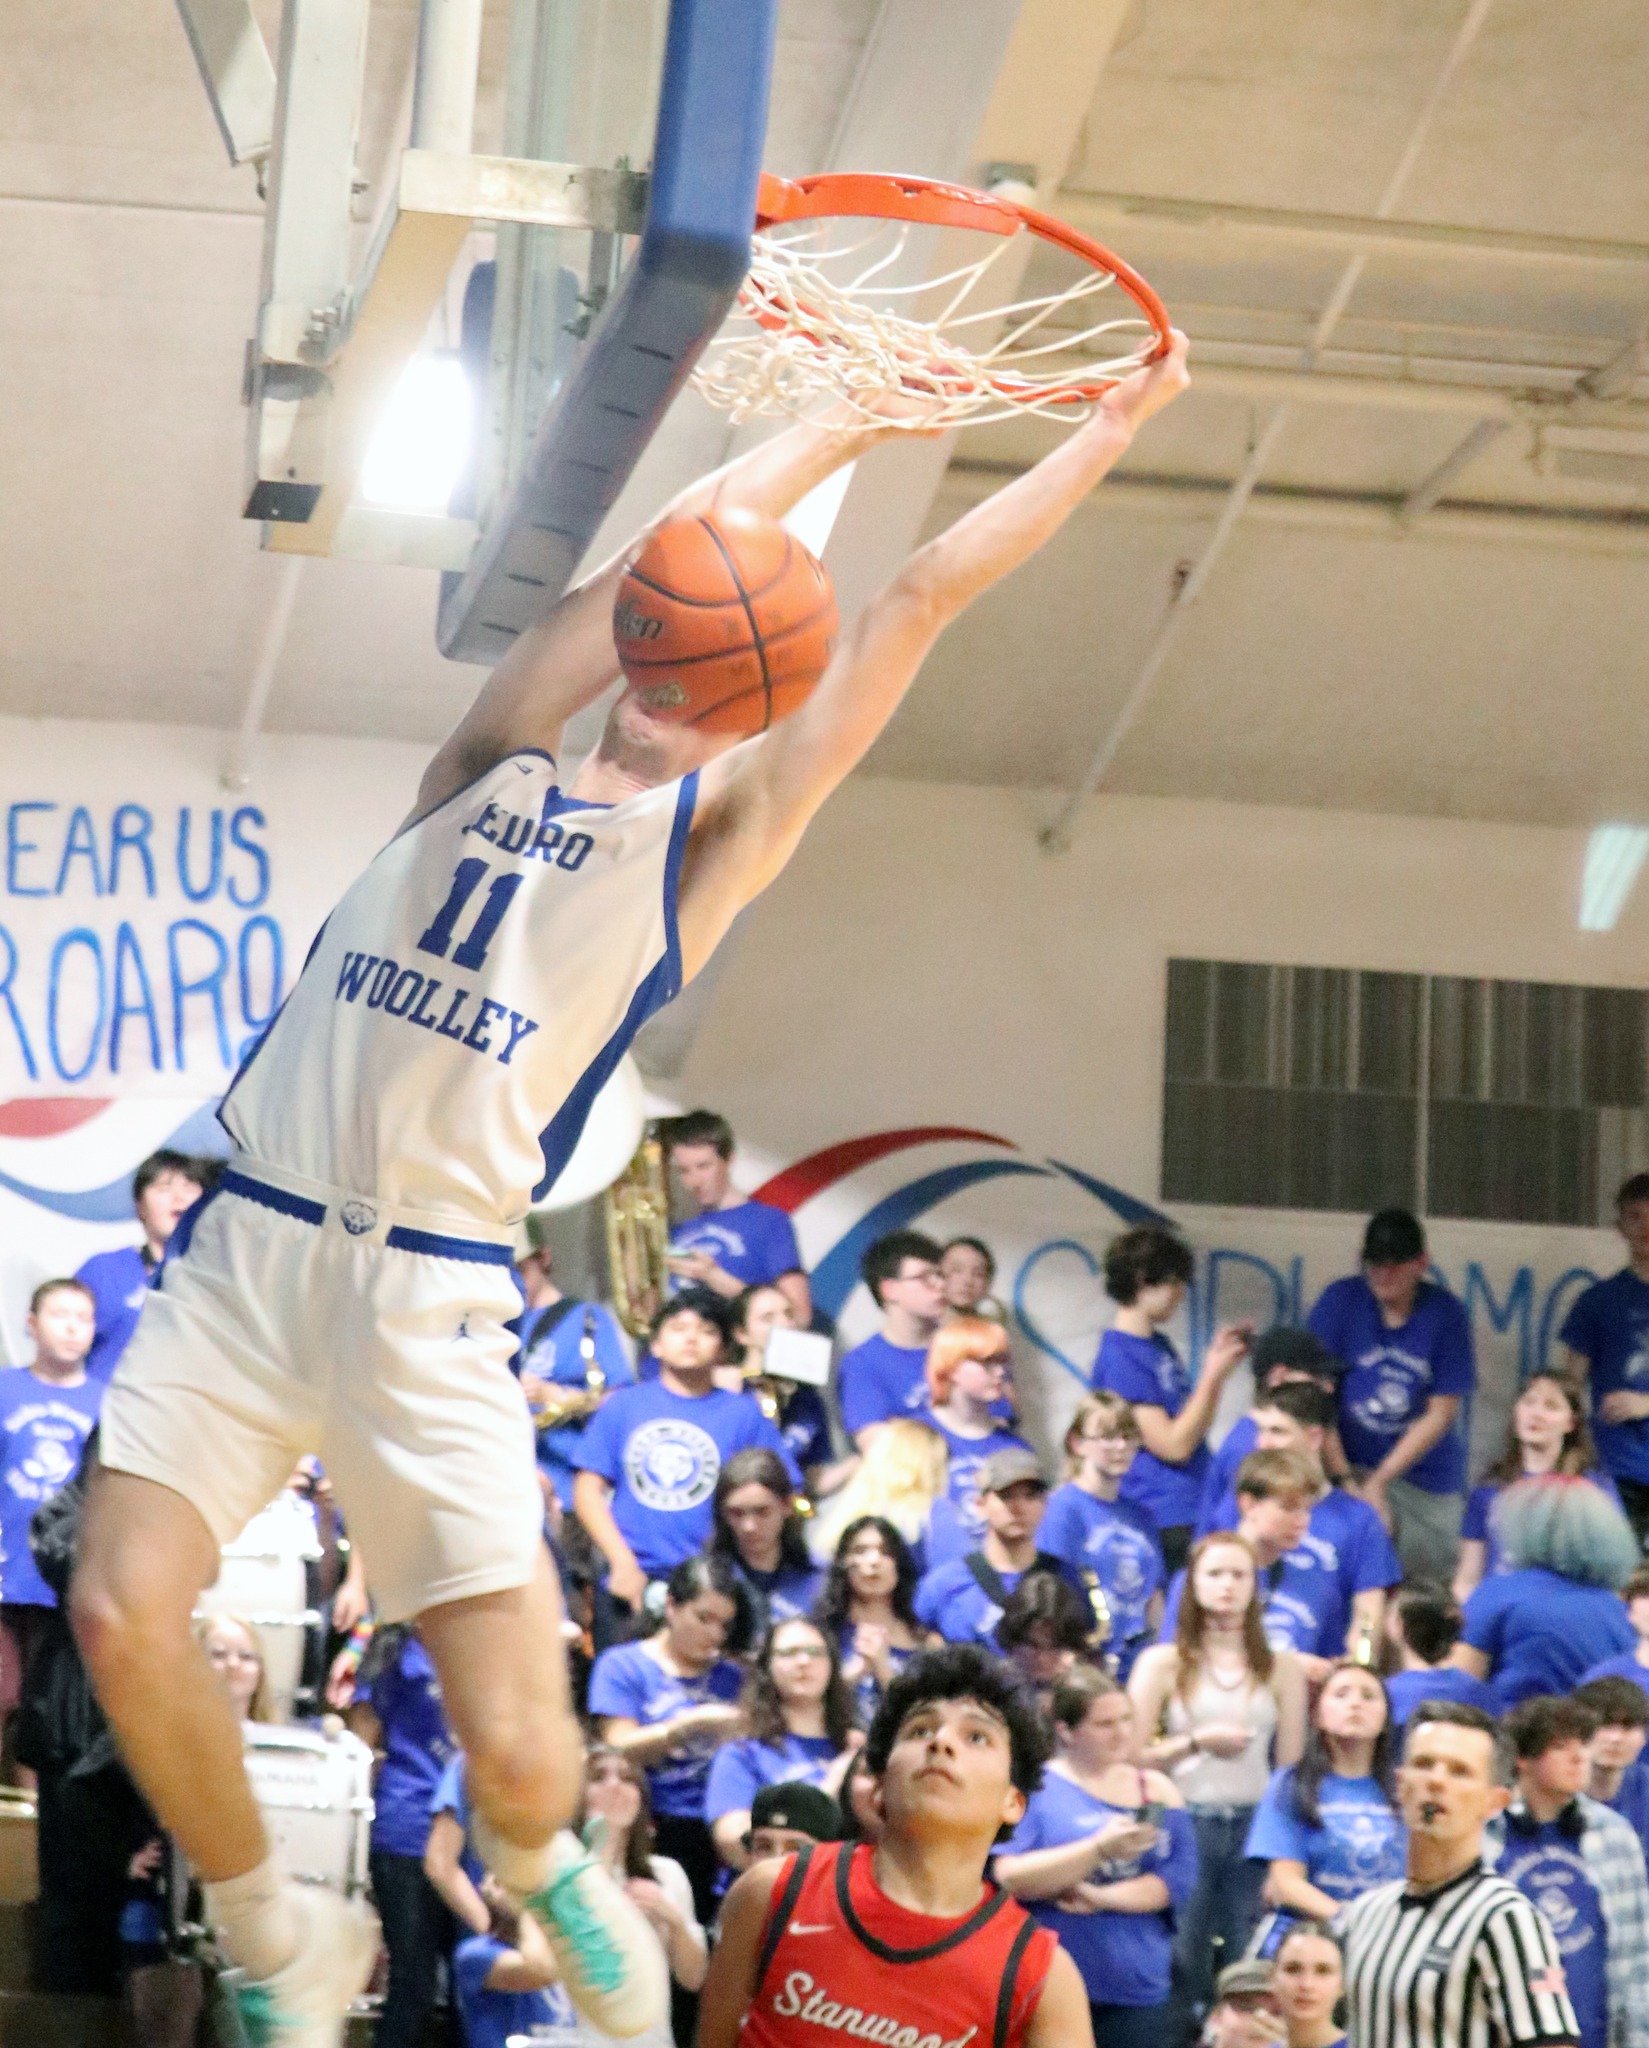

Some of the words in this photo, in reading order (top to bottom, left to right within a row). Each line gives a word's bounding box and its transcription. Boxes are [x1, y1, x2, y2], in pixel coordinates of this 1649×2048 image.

[175, 805, 271, 911] US
[416, 857, 525, 973] 11
[334, 951, 540, 1066] WOOLLEY
